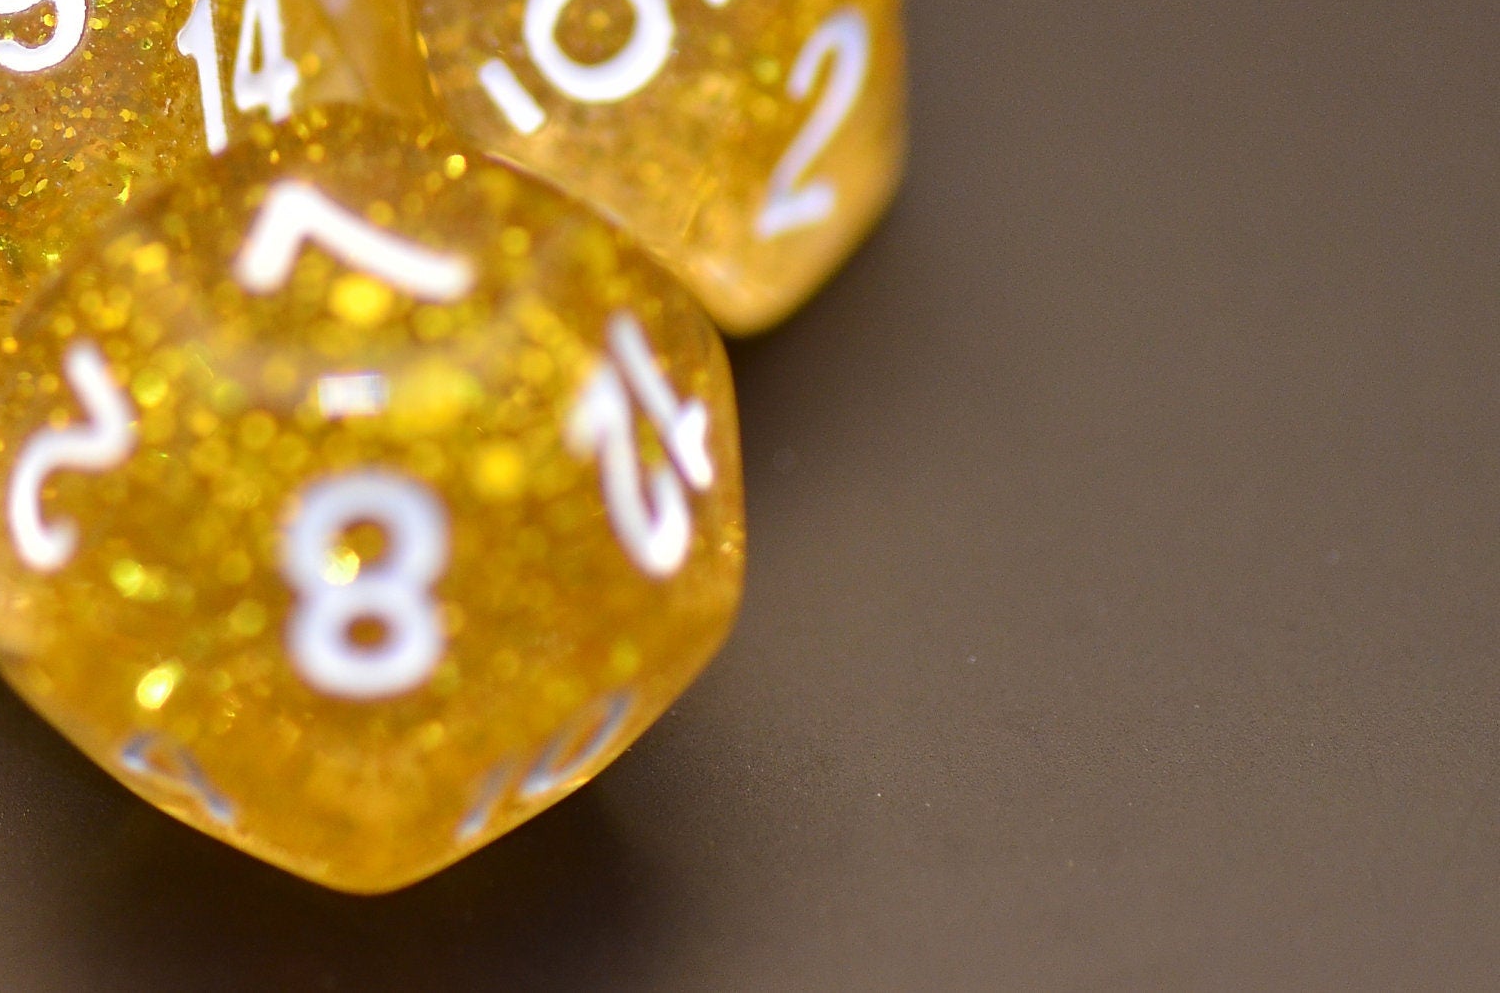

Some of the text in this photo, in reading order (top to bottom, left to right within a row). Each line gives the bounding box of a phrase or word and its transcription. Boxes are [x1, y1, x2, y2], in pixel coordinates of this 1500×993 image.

[233, 178, 475, 301] 7
[752, 6, 870, 242] 2
[8, 340, 137, 571] 2
[565, 310, 715, 579] 12
[280, 465, 450, 700] 8
